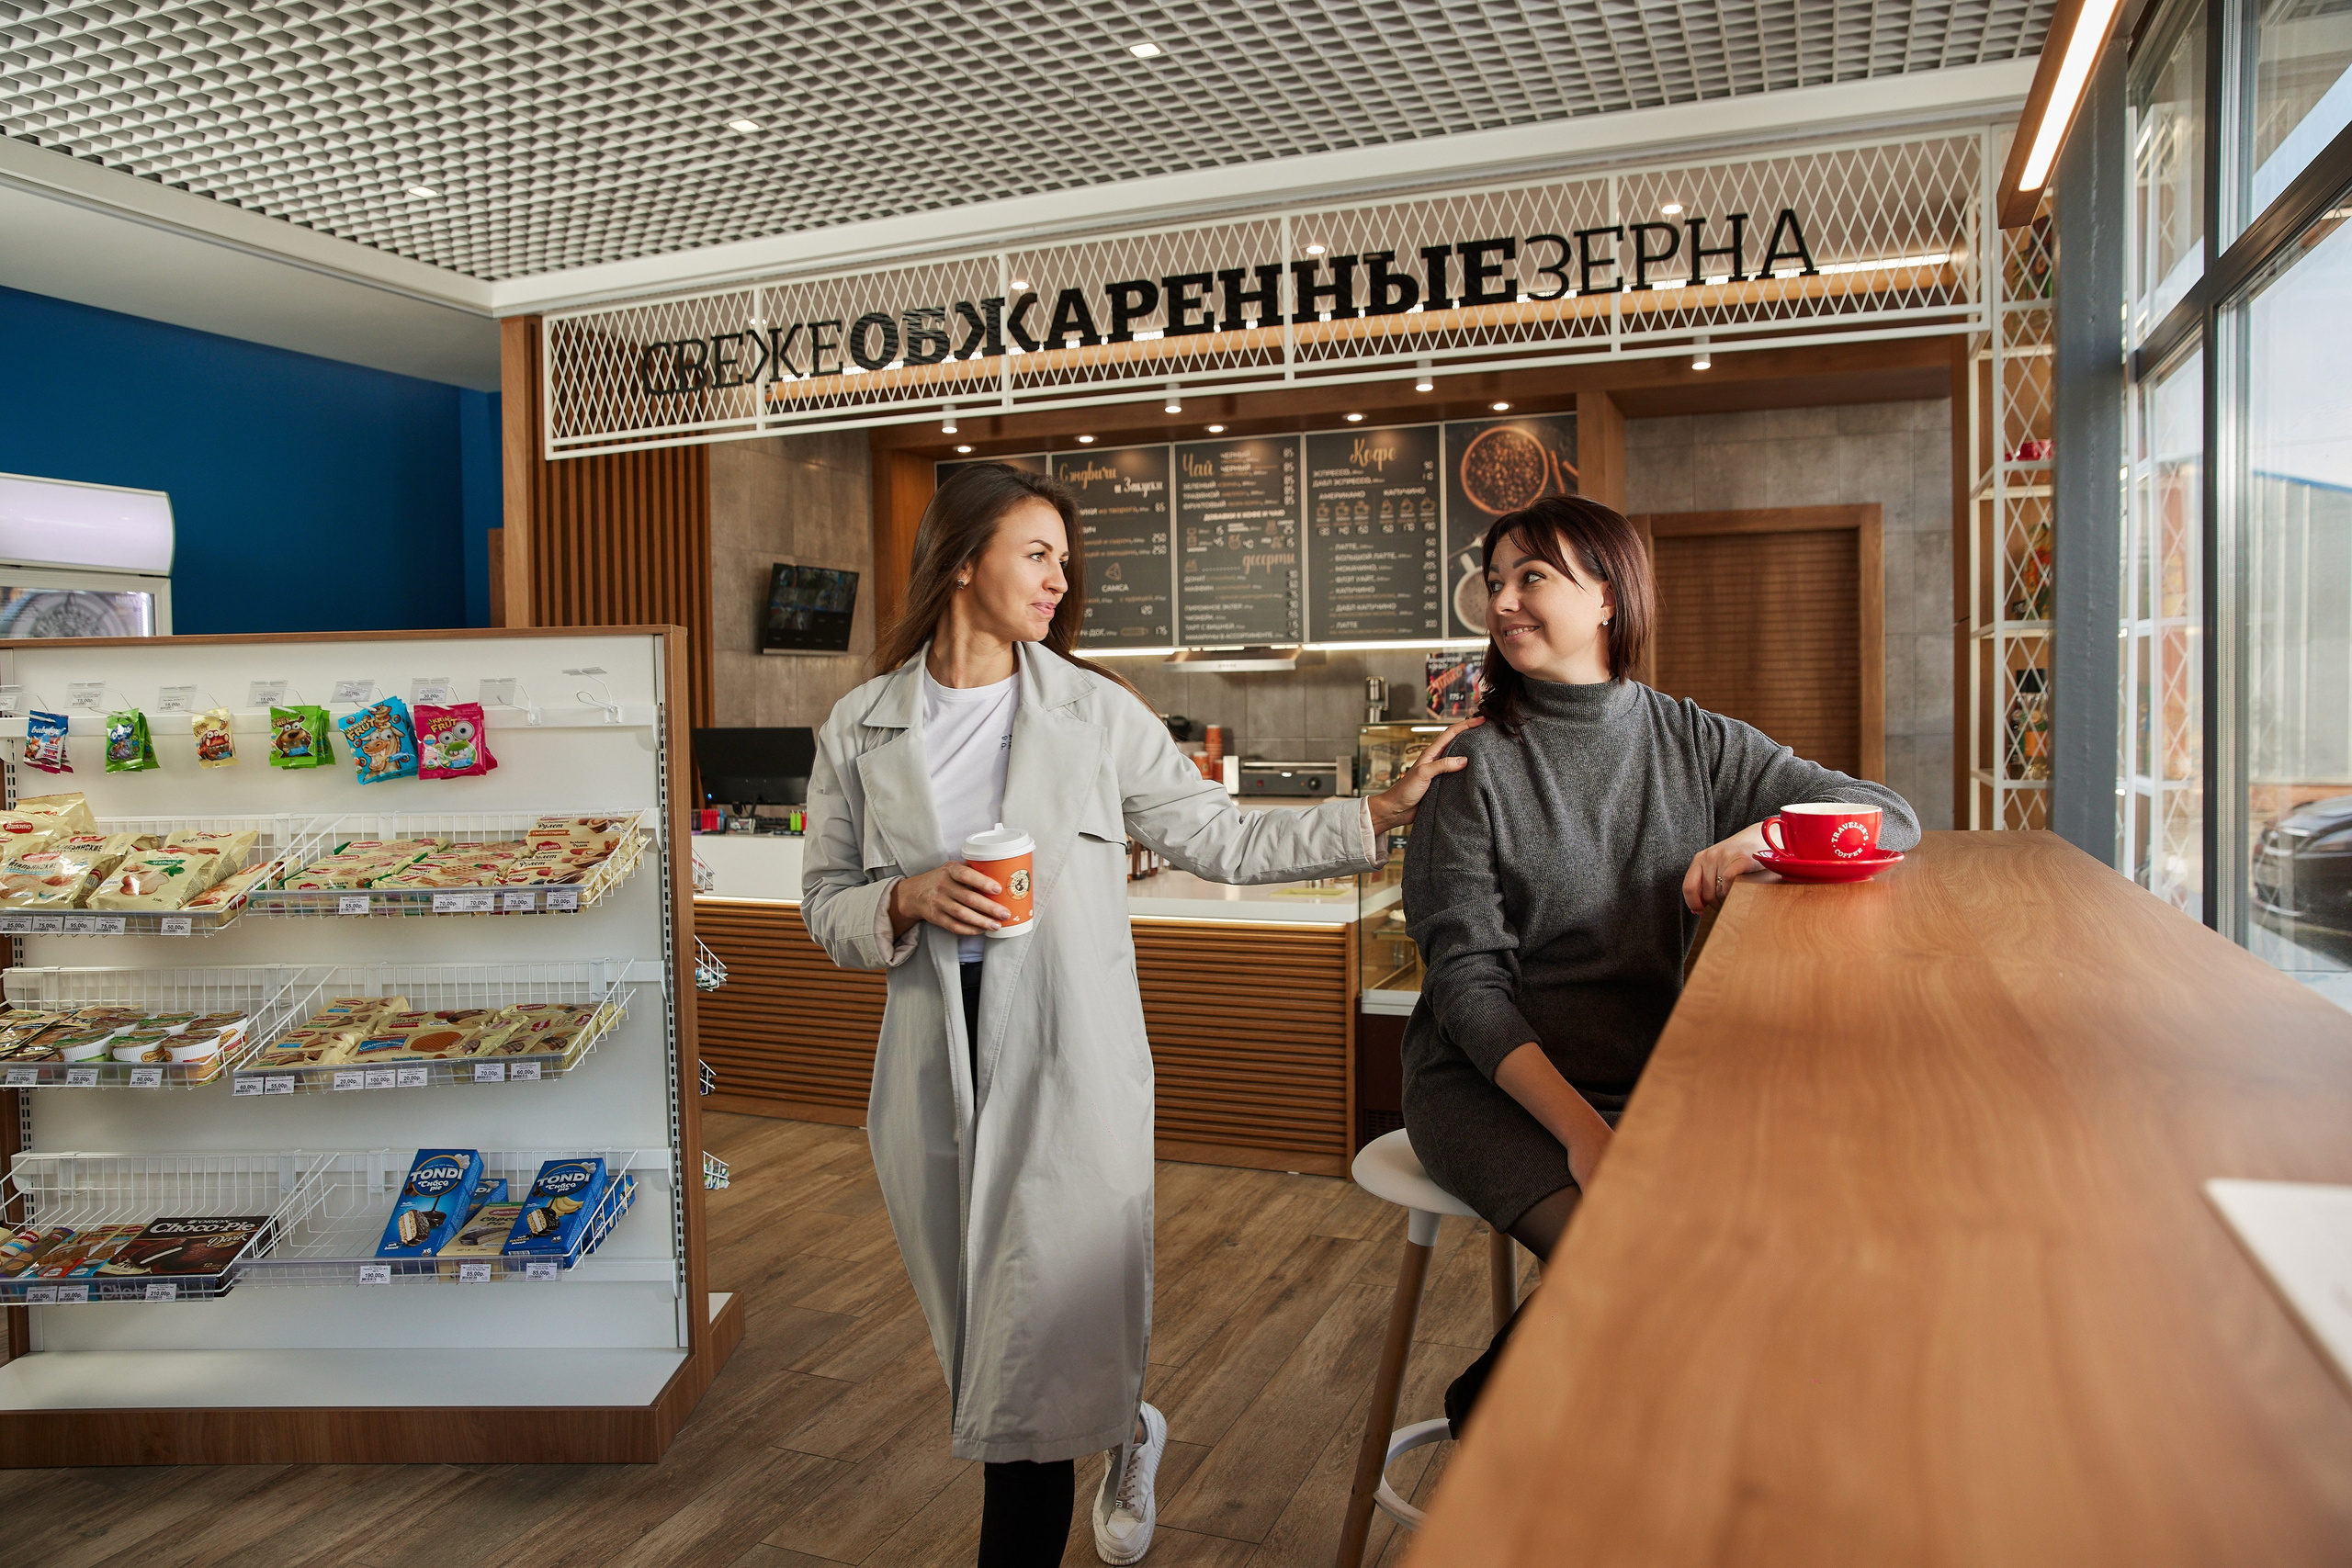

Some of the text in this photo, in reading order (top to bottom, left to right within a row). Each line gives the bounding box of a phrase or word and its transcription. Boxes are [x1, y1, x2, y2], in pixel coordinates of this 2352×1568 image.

[1350, 437, 1396, 472] Кофе
[1182, 453, 1214, 478] Чай
[346, 718, 376, 741] FRUT
[430, 718, 458, 734] FRUT
[1832, 821, 1869, 843] TRAVELER'S
[1834, 847, 1863, 859] COFFEE
[411, 1168, 463, 1182] TONDI
[537, 1172, 591, 1186] TONDI
[207, 1232, 248, 1248] Dark
